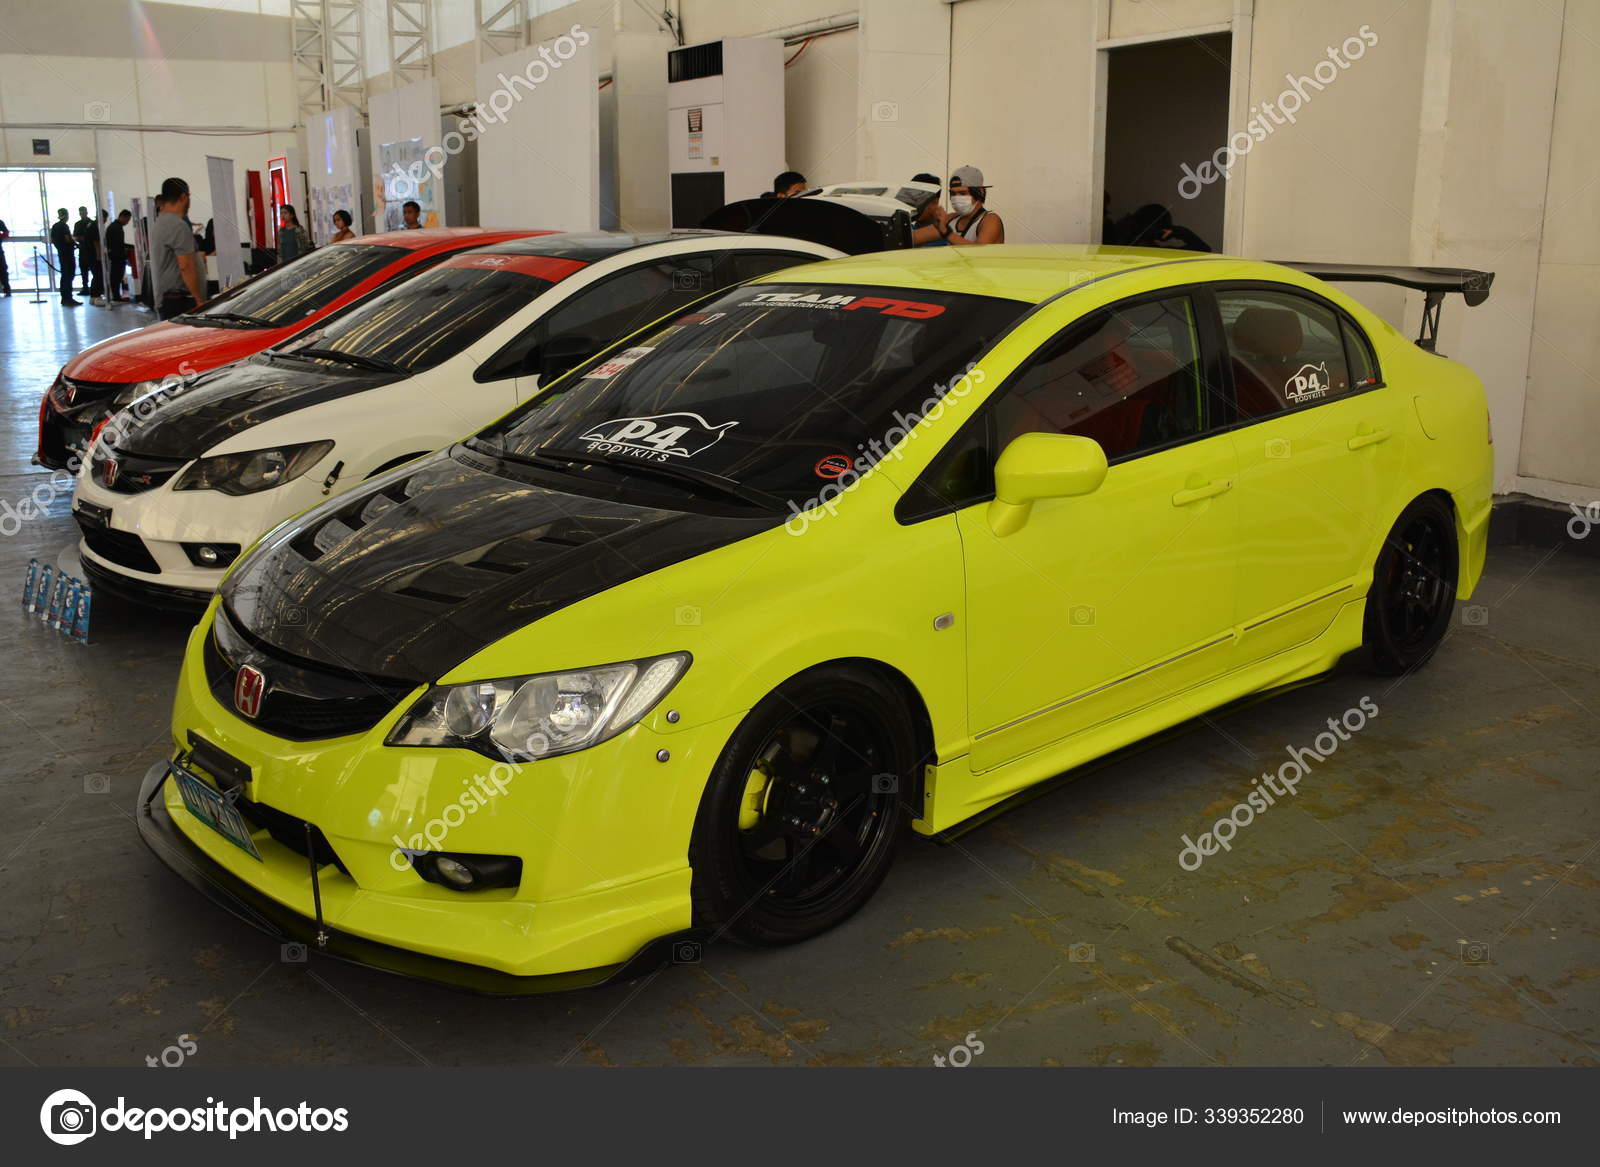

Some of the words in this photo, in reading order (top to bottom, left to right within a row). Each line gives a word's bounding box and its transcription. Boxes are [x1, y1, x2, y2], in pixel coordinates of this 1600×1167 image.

[752, 293, 857, 305] TEAM
[1294, 373, 1321, 395] P4
[1294, 390, 1326, 403] BODYKITS
[610, 419, 691, 450] P4
[586, 441, 670, 462] BODYKITS
